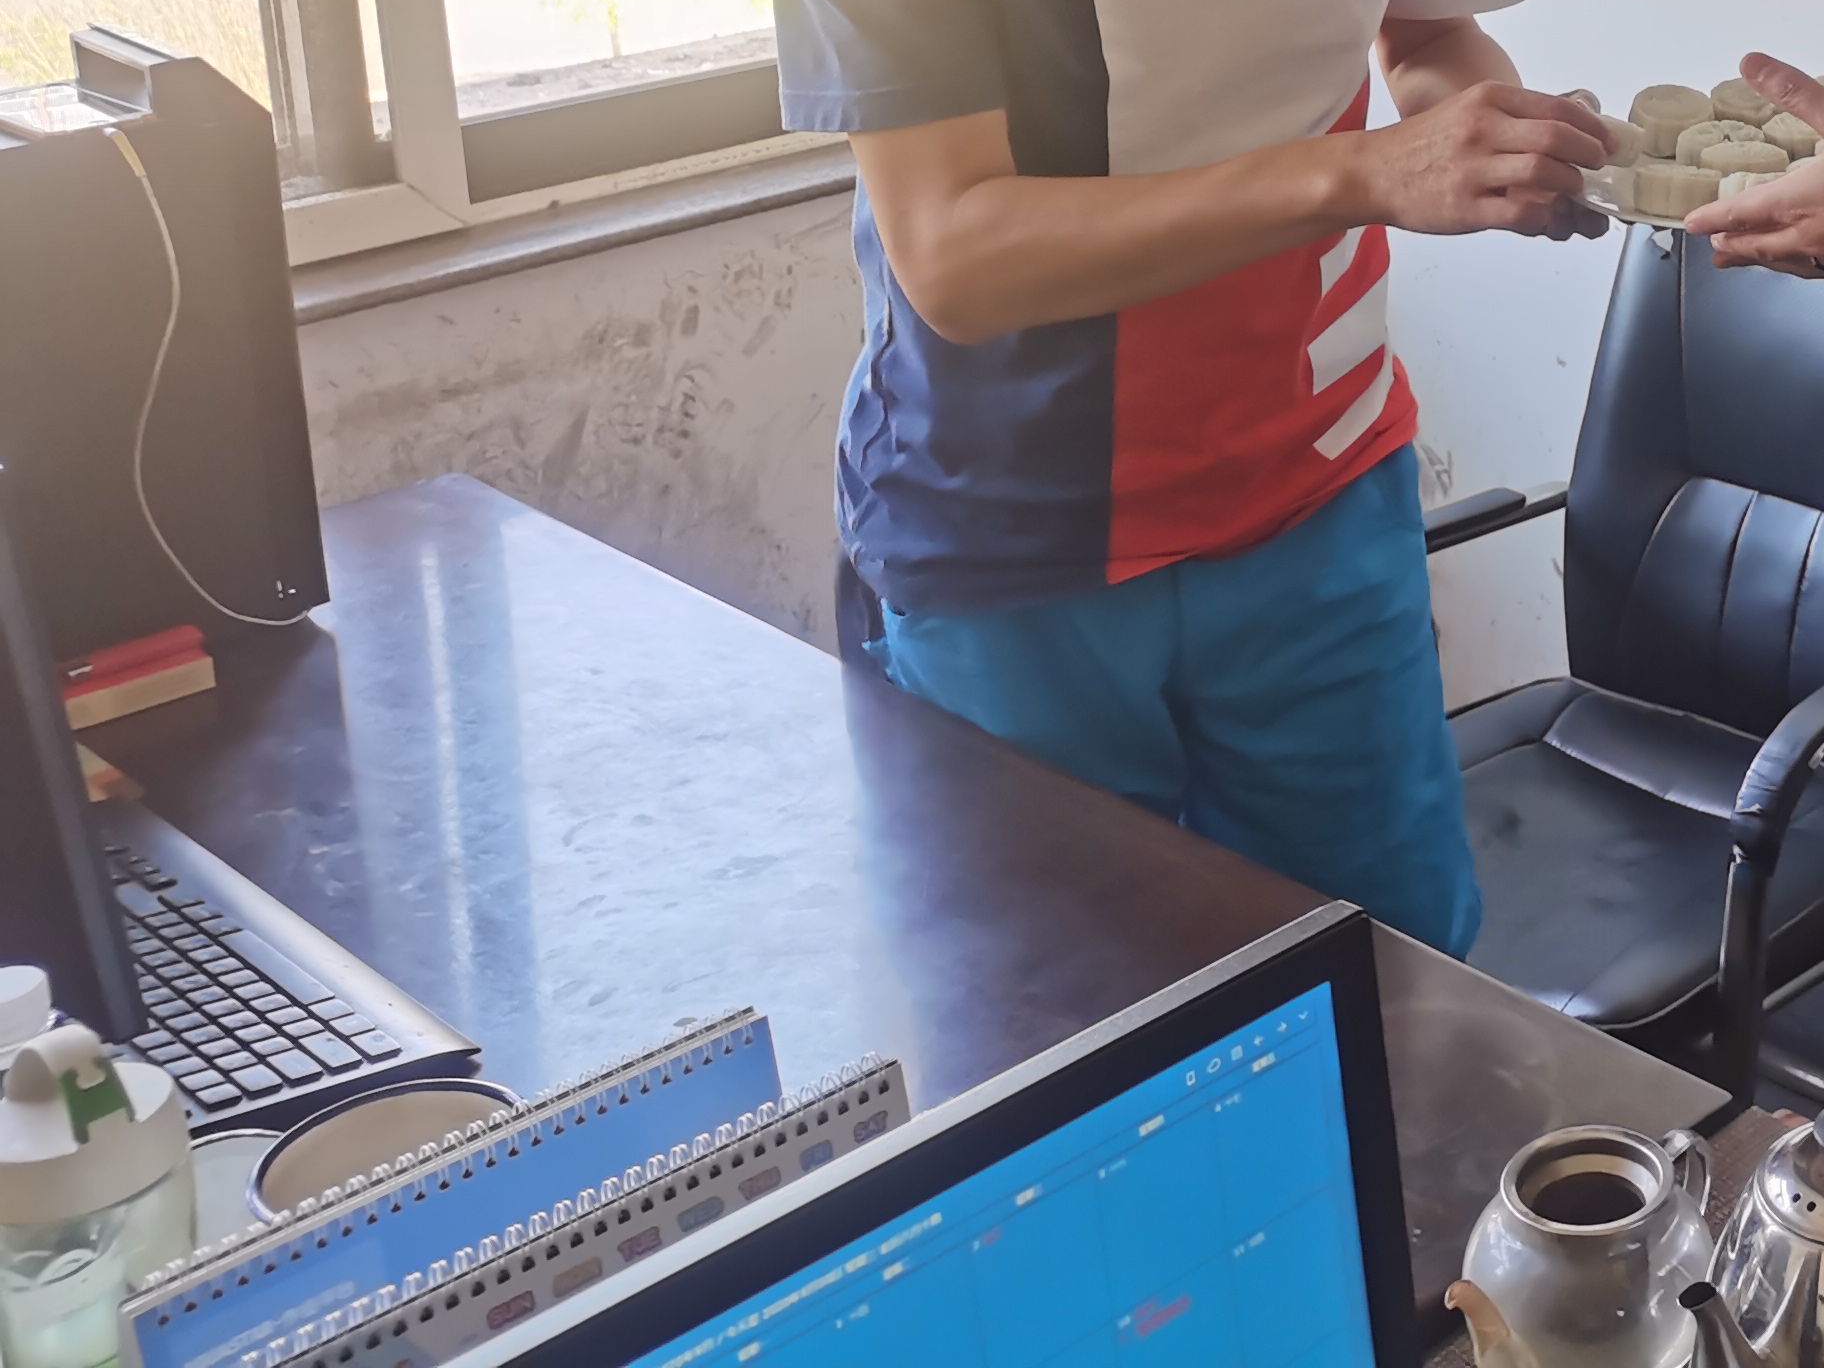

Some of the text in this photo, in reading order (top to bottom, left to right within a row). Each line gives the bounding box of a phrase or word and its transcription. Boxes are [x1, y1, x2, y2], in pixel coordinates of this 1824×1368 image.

[487, 1290, 535, 1330] SUN
[618, 1226, 662, 1262] TUE
[854, 1110, 888, 1143] SAT
